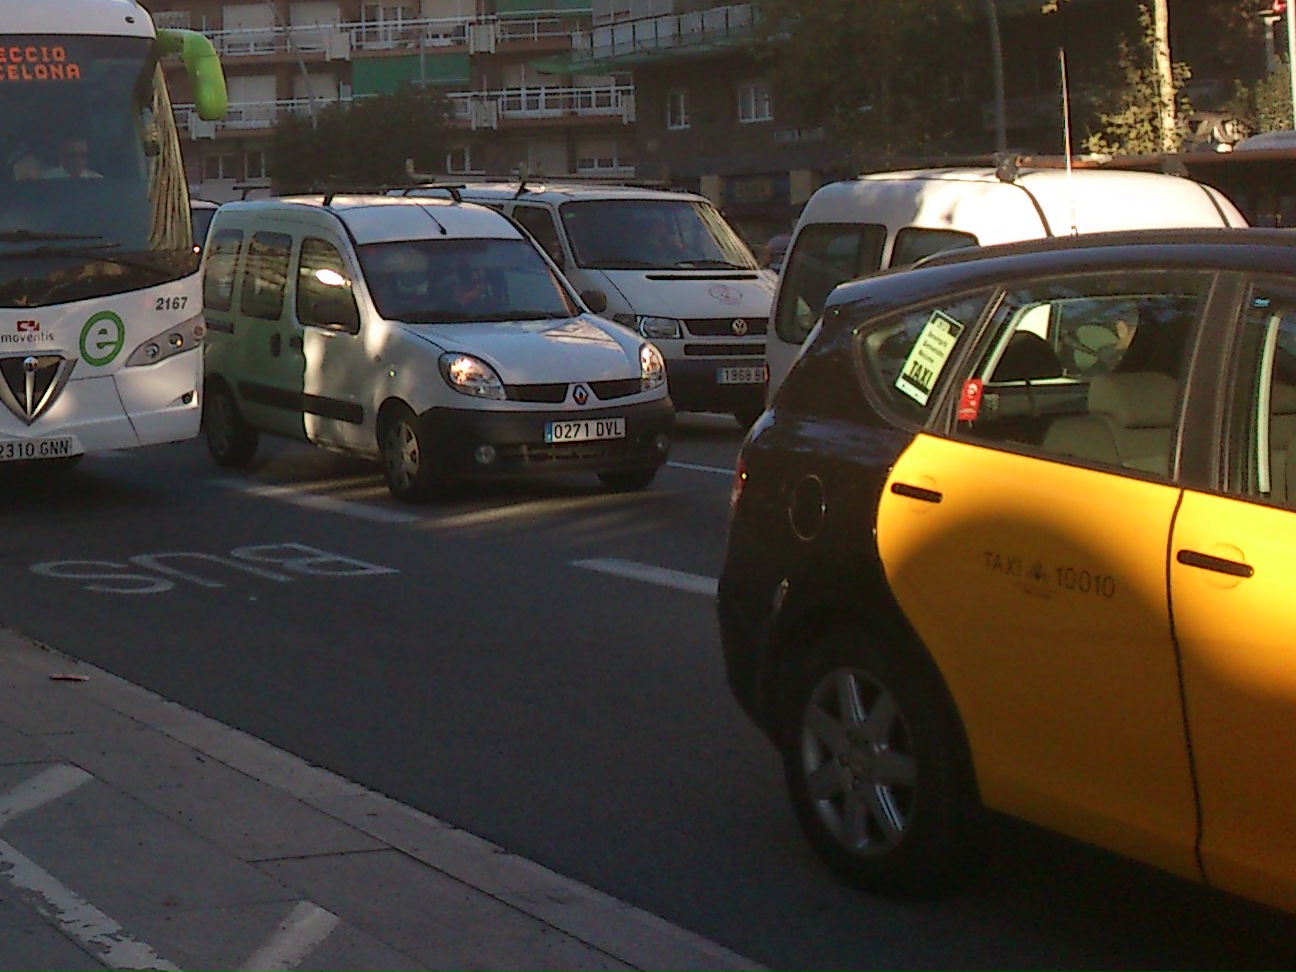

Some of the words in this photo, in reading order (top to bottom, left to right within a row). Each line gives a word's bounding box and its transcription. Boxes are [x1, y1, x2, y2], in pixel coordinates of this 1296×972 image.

[155, 296, 188, 311] 2167
[0, 330, 54, 344] moventis
[909, 360, 934, 386] TAXI
[554, 423, 590, 440] 0271
[596, 419, 622, 437] DVL
[40, 440, 69, 456] GNN
[984, 551, 1022, 576] TAXI
[1057, 567, 1115, 598] 10010
